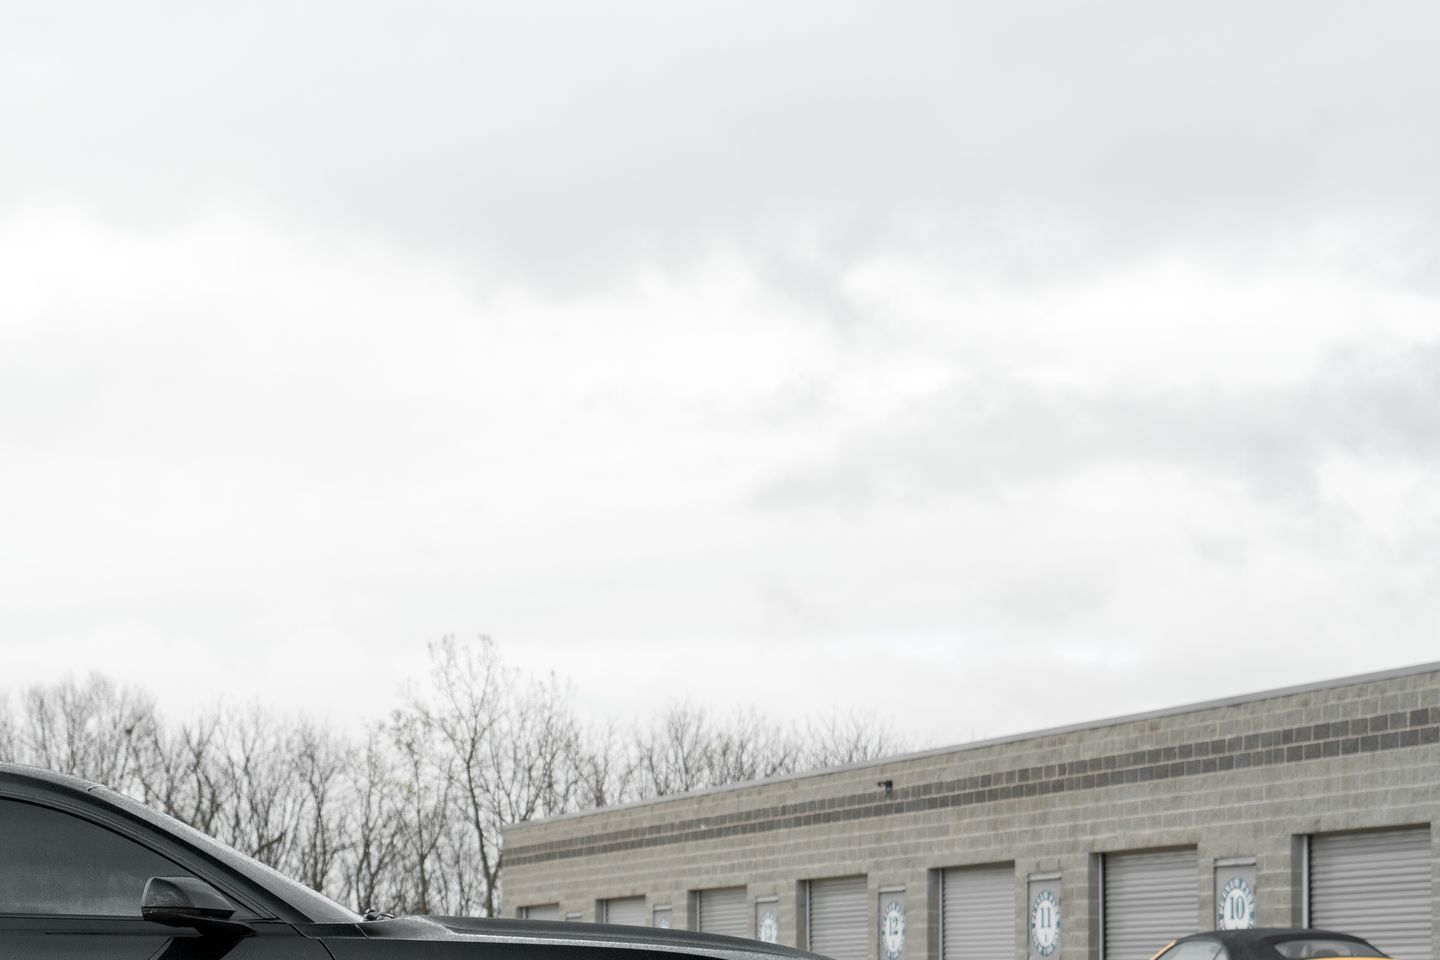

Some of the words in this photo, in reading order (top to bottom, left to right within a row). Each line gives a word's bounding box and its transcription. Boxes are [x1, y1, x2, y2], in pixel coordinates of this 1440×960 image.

[1040, 907, 1052, 929] 11
[1230, 895, 1246, 920] 10
[888, 915, 900, 936] 12
